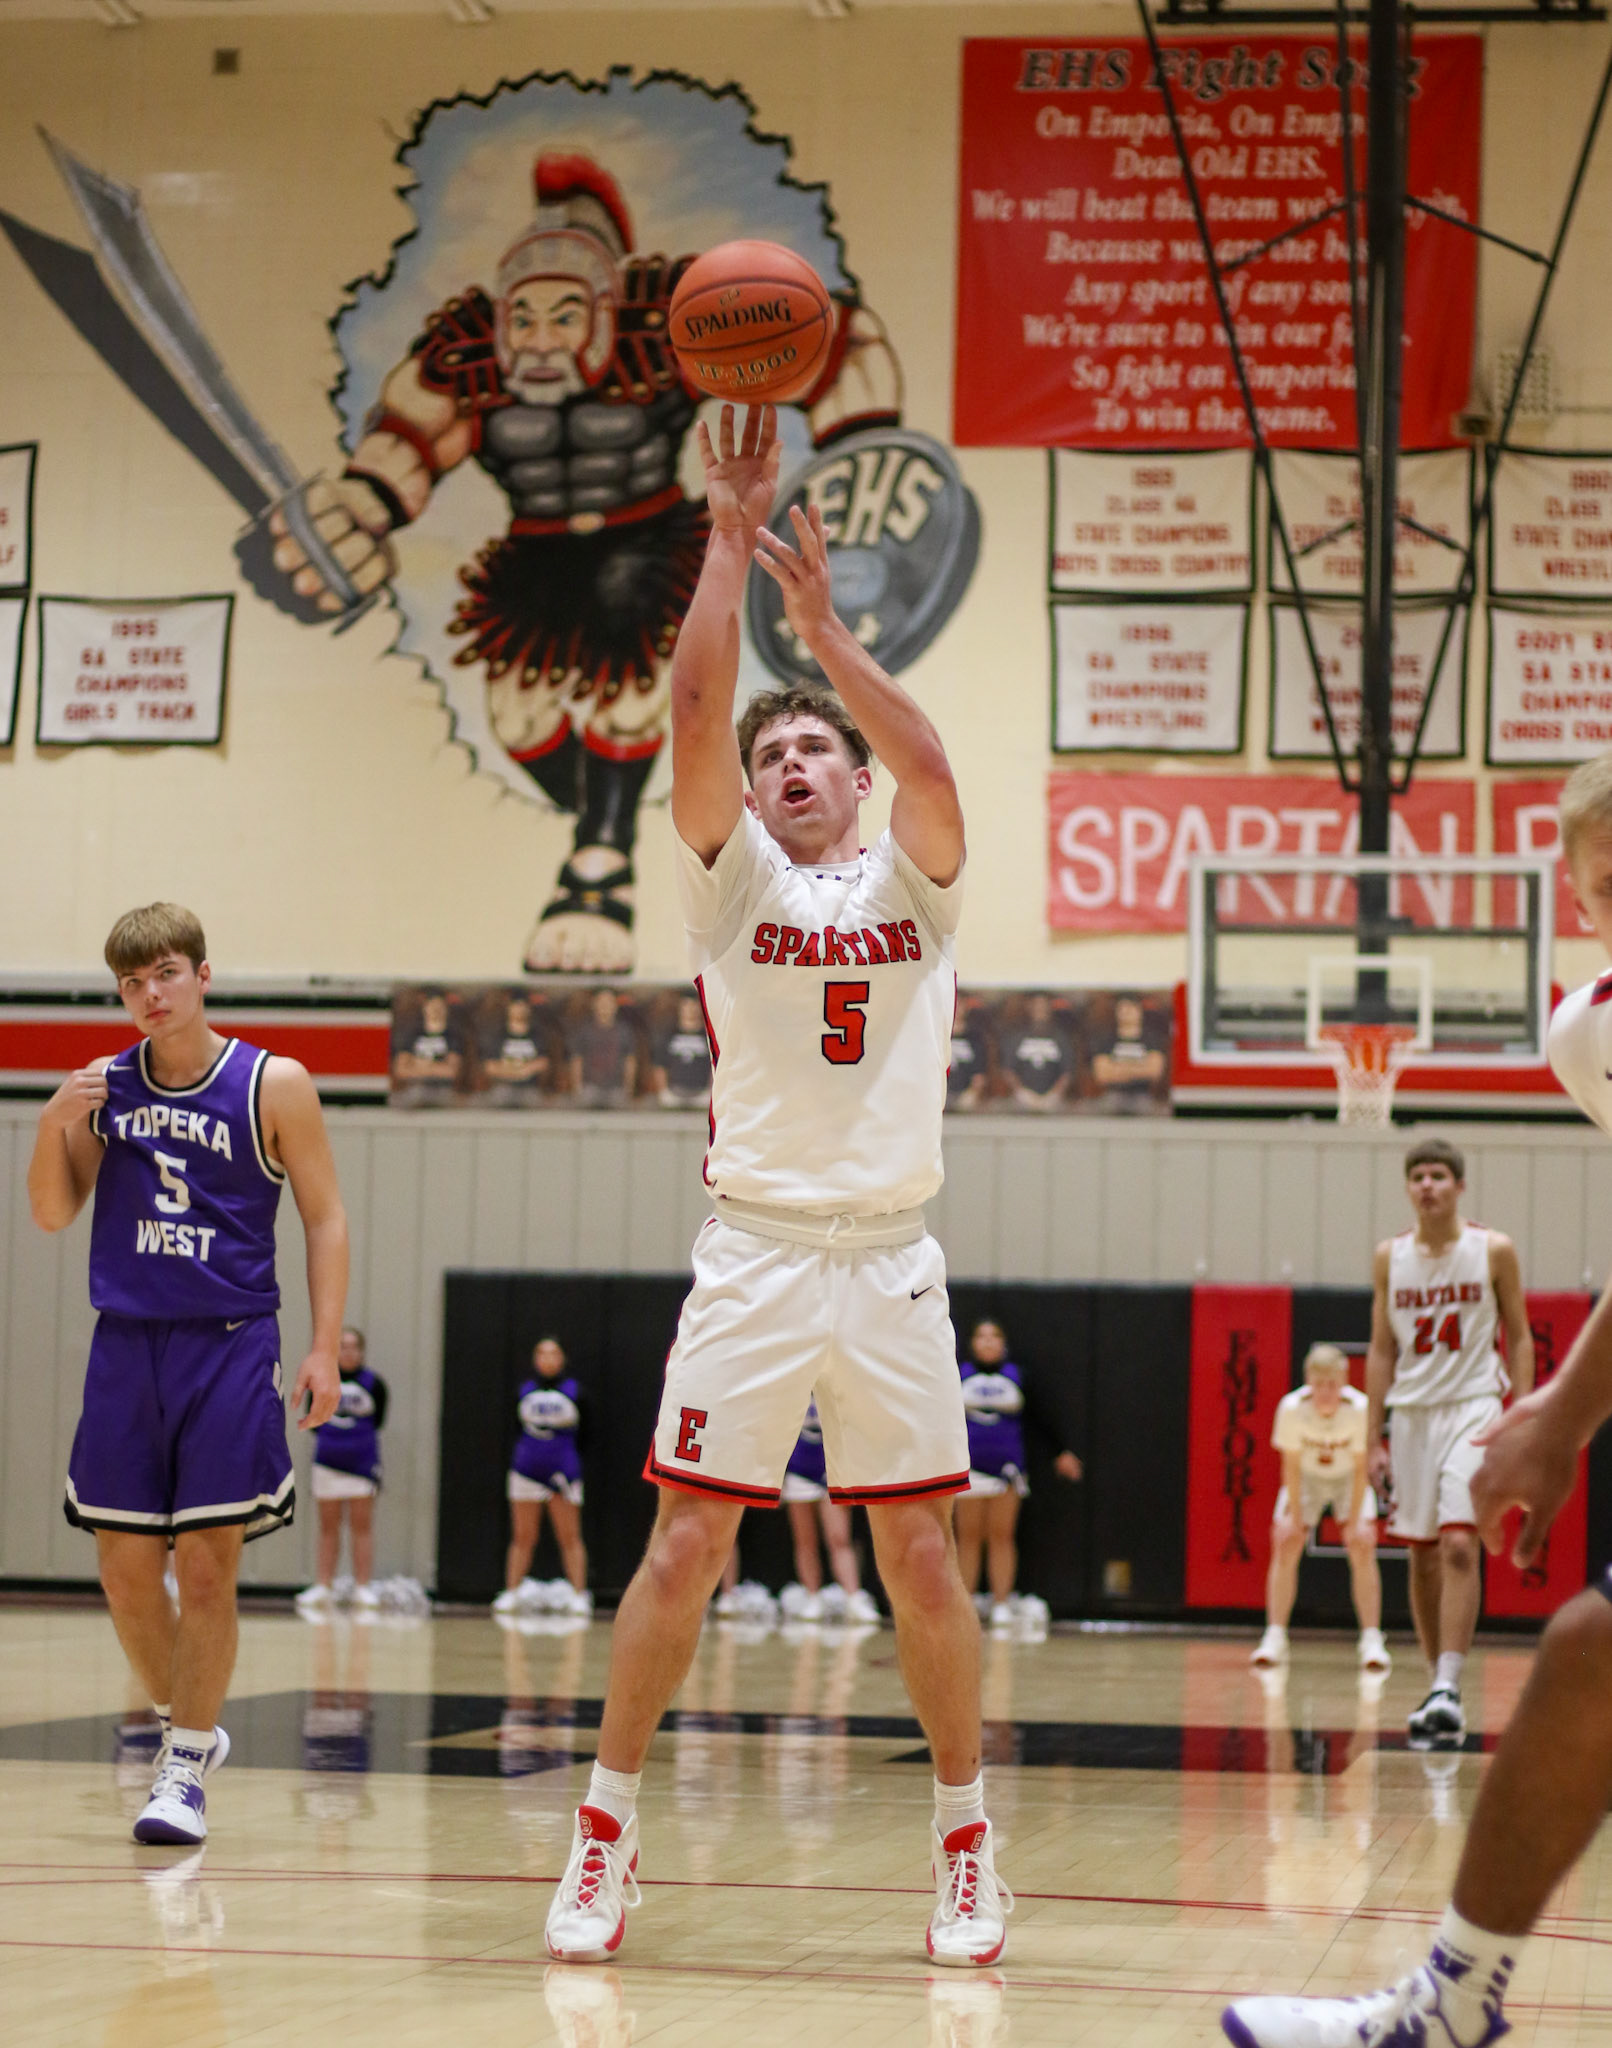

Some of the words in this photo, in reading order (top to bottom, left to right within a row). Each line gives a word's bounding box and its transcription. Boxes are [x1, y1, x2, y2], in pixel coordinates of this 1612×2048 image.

[1015, 48, 1131, 92] EHS
[1141, 45, 1287, 102] Fight
[1298, 47, 1428, 101] Sog
[1036, 105, 1081, 138] On
[1229, 104, 1275, 138] On
[1193, 146, 1249, 178] Old
[972, 188, 1015, 221] We
[1021, 188, 1079, 221] will
[1083, 188, 1147, 221] beat
[1153, 187, 1200, 221] the
[1207, 193, 1279, 221] team
[1046, 231, 1163, 263] Because
[1065, 273, 1125, 315] Any
[1130, 276, 1208, 315] sport
[1249, 280, 1307, 315] any
[685, 298, 796, 342] SPALDING
[1023, 312, 1101, 347] We're
[1105, 323, 1170, 347] sure
[1173, 318, 1207, 347] to
[1212, 314, 1267, 347] win
[1272, 322, 1328, 347] our
[1071, 354, 1110, 390] So
[1108, 354, 1183, 399] fight
[1187, 364, 1226, 389] on
[1092, 397, 1130, 431] To
[1135, 398, 1191, 431] win
[1196, 396, 1244, 431] the
[806, 448, 944, 546] EHS
[128, 647, 185, 666] STATE
[1151, 652, 1208, 674] STATE
[75, 674, 188, 694] CHAMPIONS
[1089, 682, 1207, 702] CHAMPIONS
[64, 704, 117, 723] GIRLS
[137, 702, 196, 721] TRACK
[1089, 710, 1207, 732] WRESTLING
[1058, 804, 1458, 929] SPARTAN
[751, 918, 922, 966] SPARTANS
[821, 980, 870, 1065] 5
[114, 1104, 233, 1162] TOPEKA
[153, 1150, 192, 1215] 5
[136, 1219, 217, 1262] WEST
[1395, 1282, 1482, 1309] SPARTANS
[1414, 1312, 1462, 1355] 24
[674, 1406, 708, 1463] E
